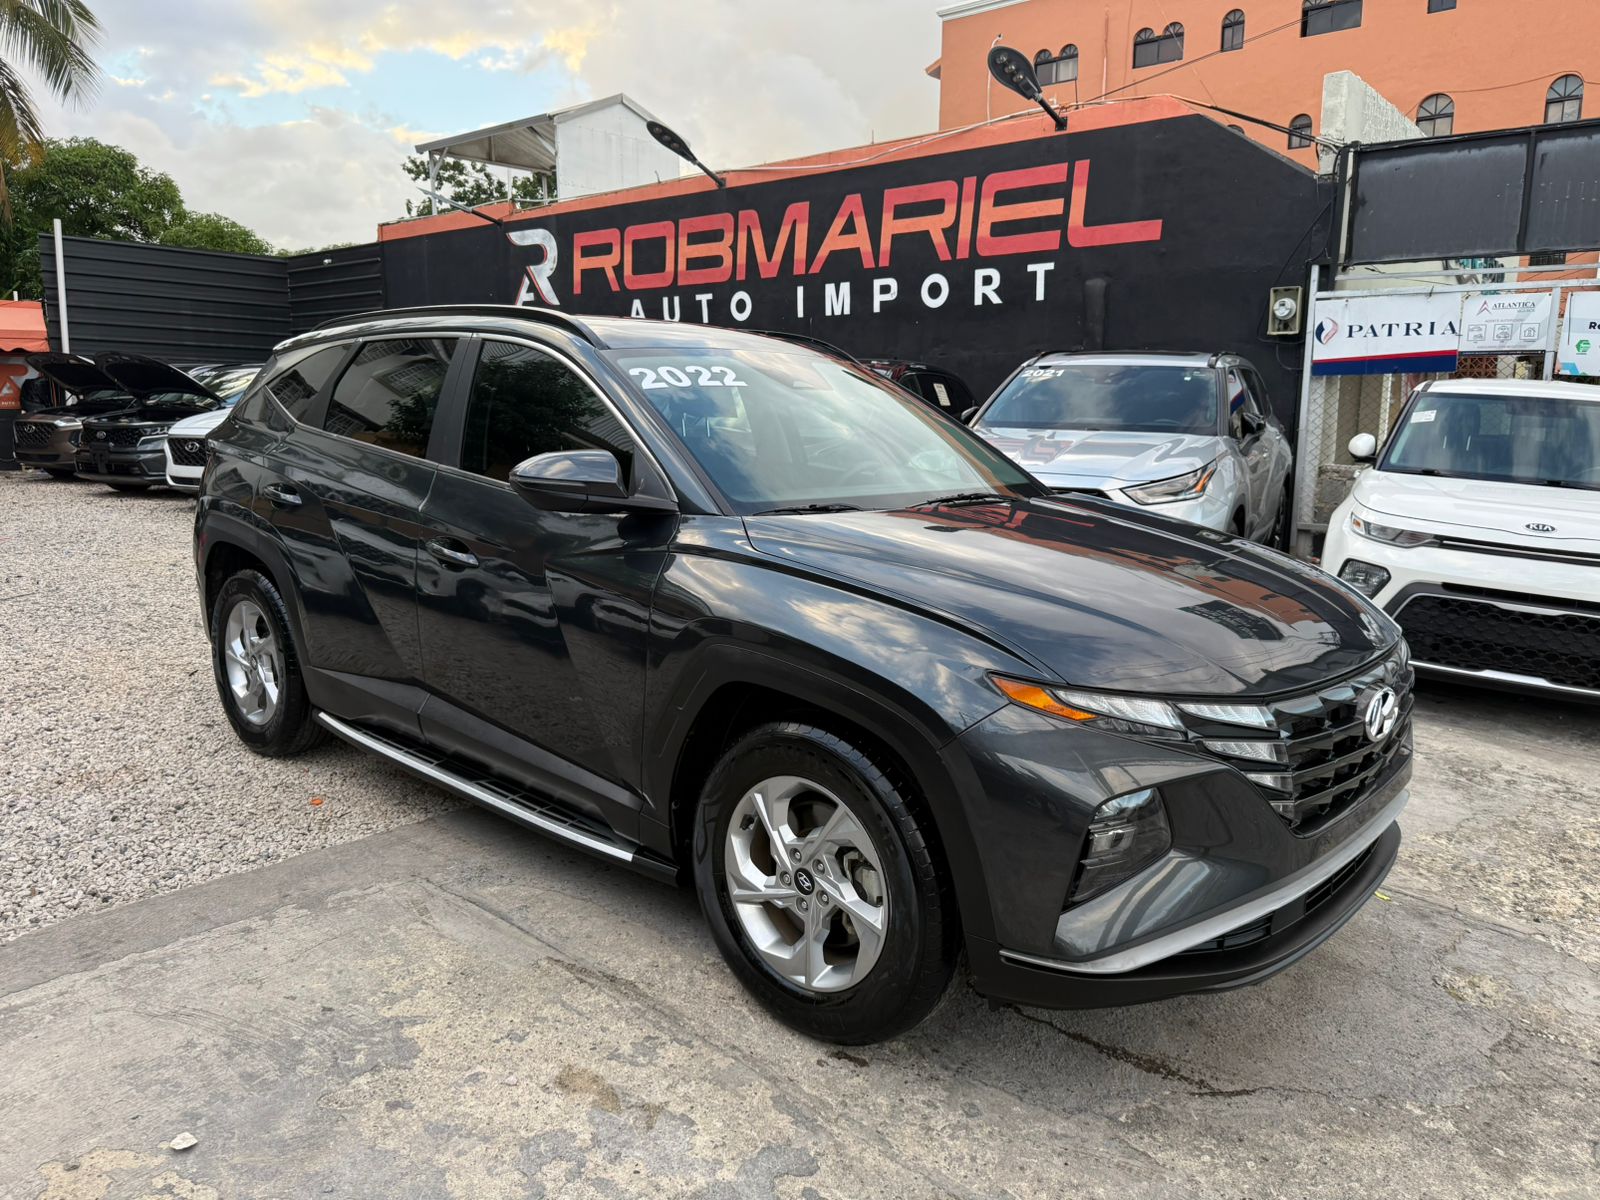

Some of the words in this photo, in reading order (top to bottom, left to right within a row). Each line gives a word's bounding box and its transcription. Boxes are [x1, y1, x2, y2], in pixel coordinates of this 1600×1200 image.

[573, 159, 1163, 295] ROBMARIEL
[630, 290, 753, 324] AUTO
[796, 262, 1056, 320] IMPORT
[1347, 320, 1460, 338] PATRIA
[629, 365, 748, 390] 2022
[1021, 369, 1065, 377] 2021
[1529, 523, 1552, 531] KIA
